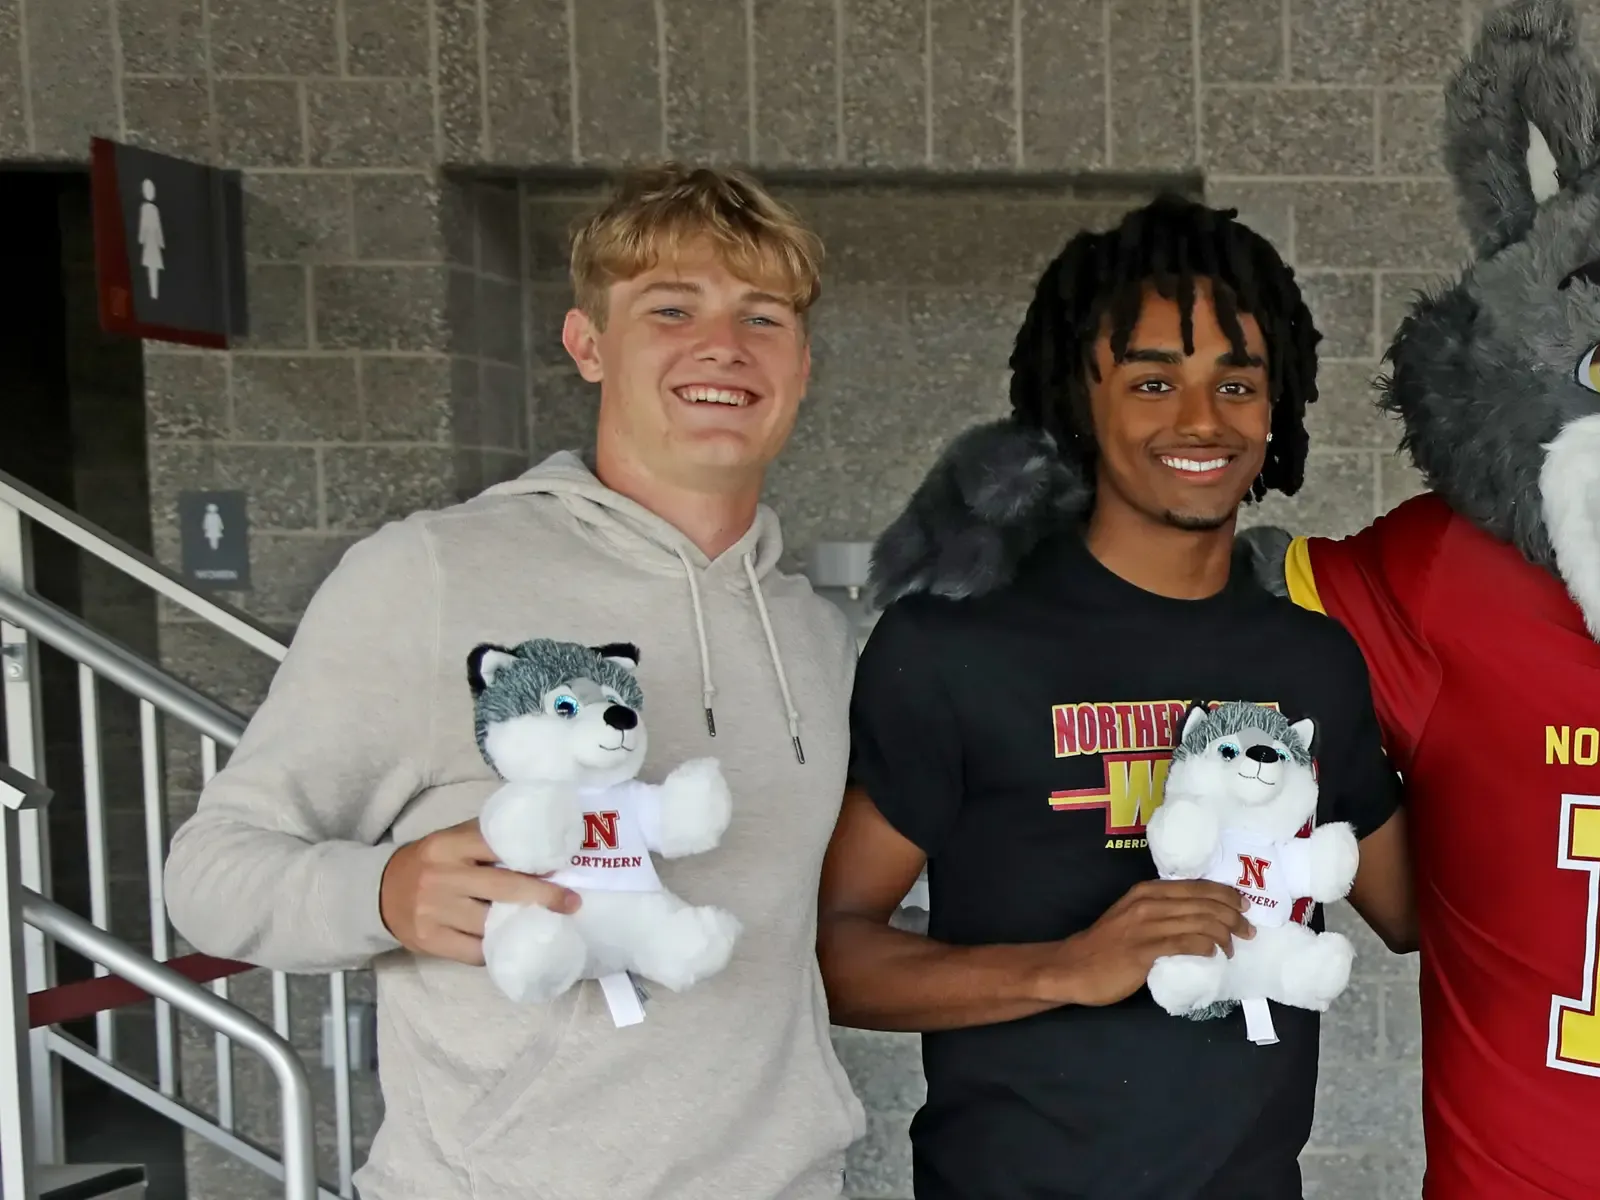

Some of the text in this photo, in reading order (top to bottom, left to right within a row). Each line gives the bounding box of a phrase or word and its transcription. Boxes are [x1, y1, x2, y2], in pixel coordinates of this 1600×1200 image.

[580, 809, 620, 850] N
[1105, 838, 1147, 849] ABERD
[570, 855, 642, 868] ORTHERN
[1236, 853, 1272, 891] N
